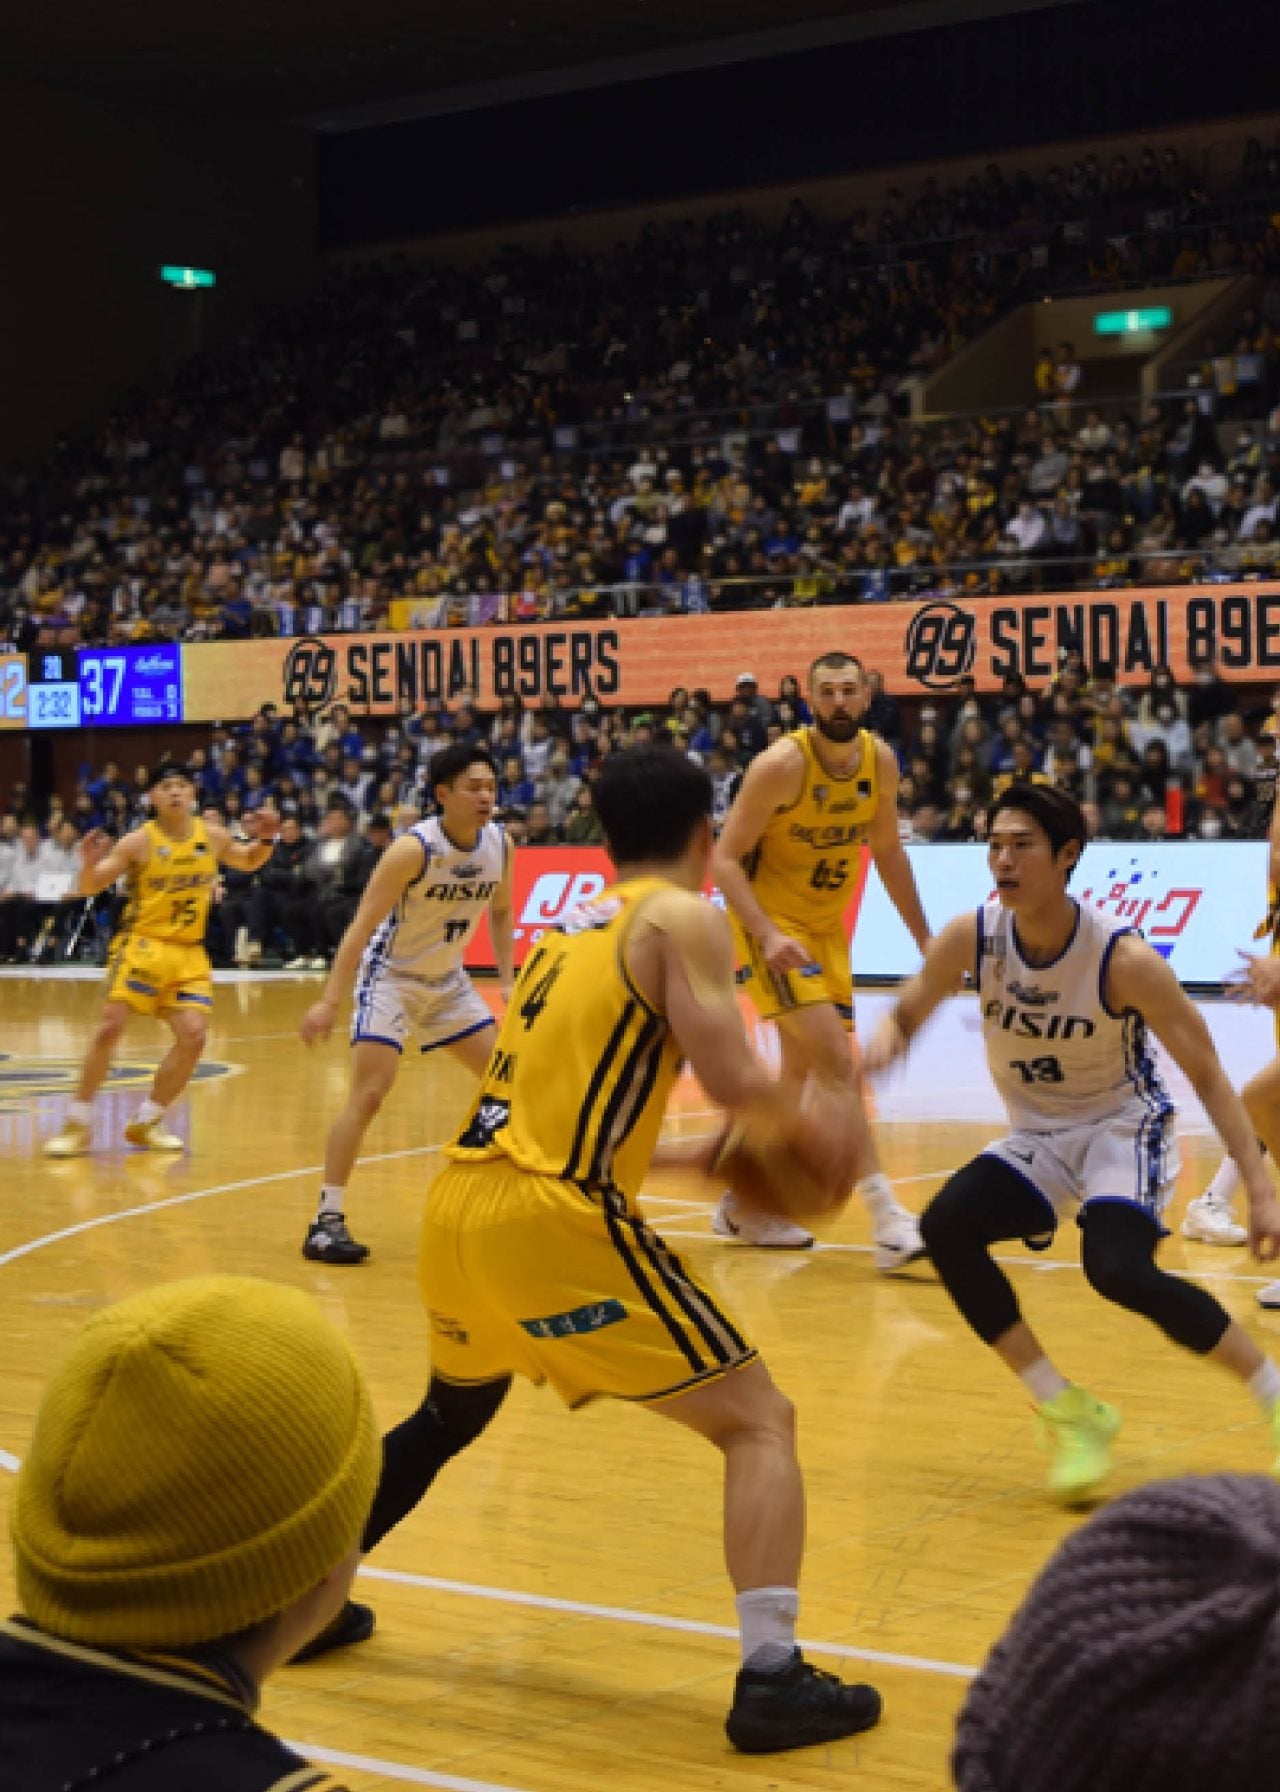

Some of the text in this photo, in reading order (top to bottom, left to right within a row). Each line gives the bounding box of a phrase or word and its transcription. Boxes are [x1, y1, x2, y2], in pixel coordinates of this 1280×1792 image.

[348, 638, 480, 705] SENDAI
[493, 630, 620, 697] 89ERS
[990, 600, 1170, 676] SENDAI
[0, 662, 27, 718] 2
[81, 656, 127, 715] 37
